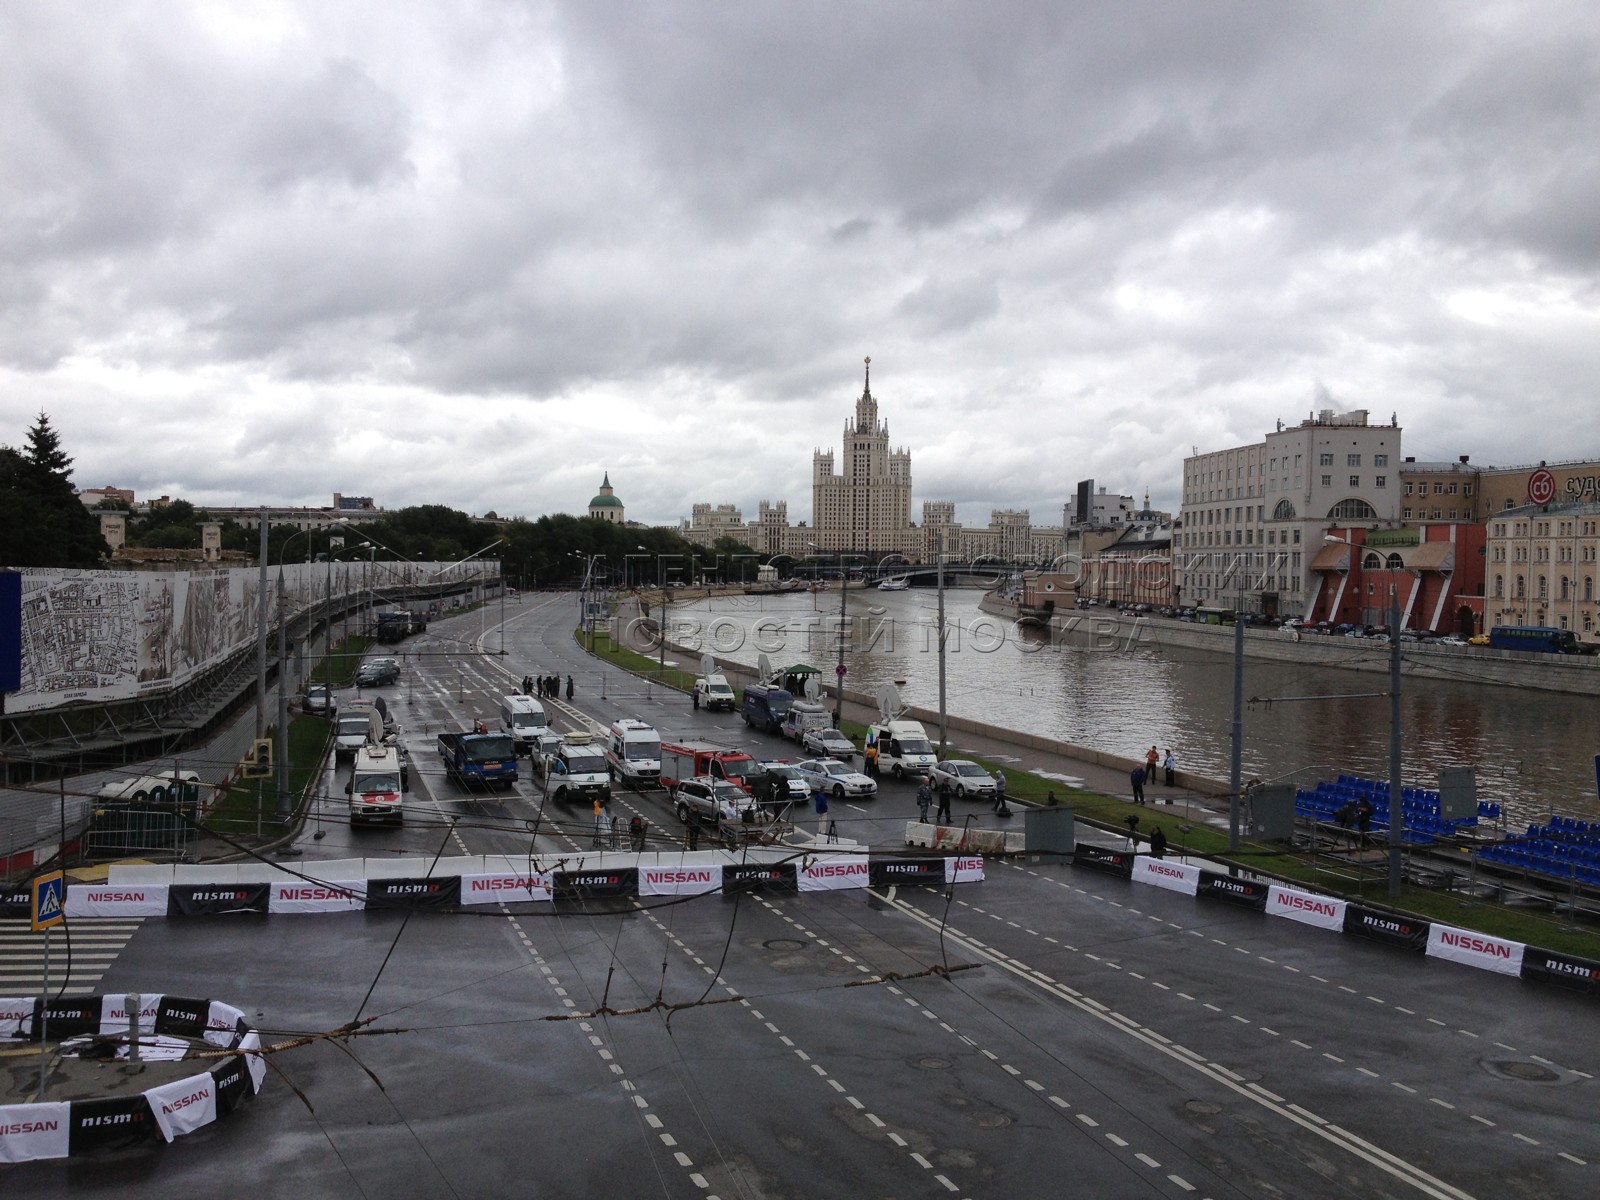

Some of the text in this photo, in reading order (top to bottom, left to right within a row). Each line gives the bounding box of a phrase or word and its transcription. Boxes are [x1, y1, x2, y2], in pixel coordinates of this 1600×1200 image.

[808, 864, 868, 878] NISSAN
[886, 863, 928, 873] nismo
[1148, 864, 1184, 879] NISSAN
[472, 877, 540, 891] NISSAN
[646, 871, 711, 883] NISSAN
[280, 888, 354, 900] NISSAN
[387, 883, 441, 894] nismo
[1213, 879, 1255, 895] nismo
[88, 893, 145, 902] NISSAN
[192, 891, 249, 901] nismo
[1278, 893, 1336, 917] NISSAN
[1363, 915, 1411, 935] nismo
[1441, 931, 1512, 959] NISSAN
[1545, 959, 1600, 980] nismo
[41, 1010, 93, 1019] nismo
[166, 1008, 204, 1021] nismo
[218, 1070, 245, 1089] nismo
[162, 1088, 209, 1115] NISSAN
[81, 1112, 145, 1127] nismo
